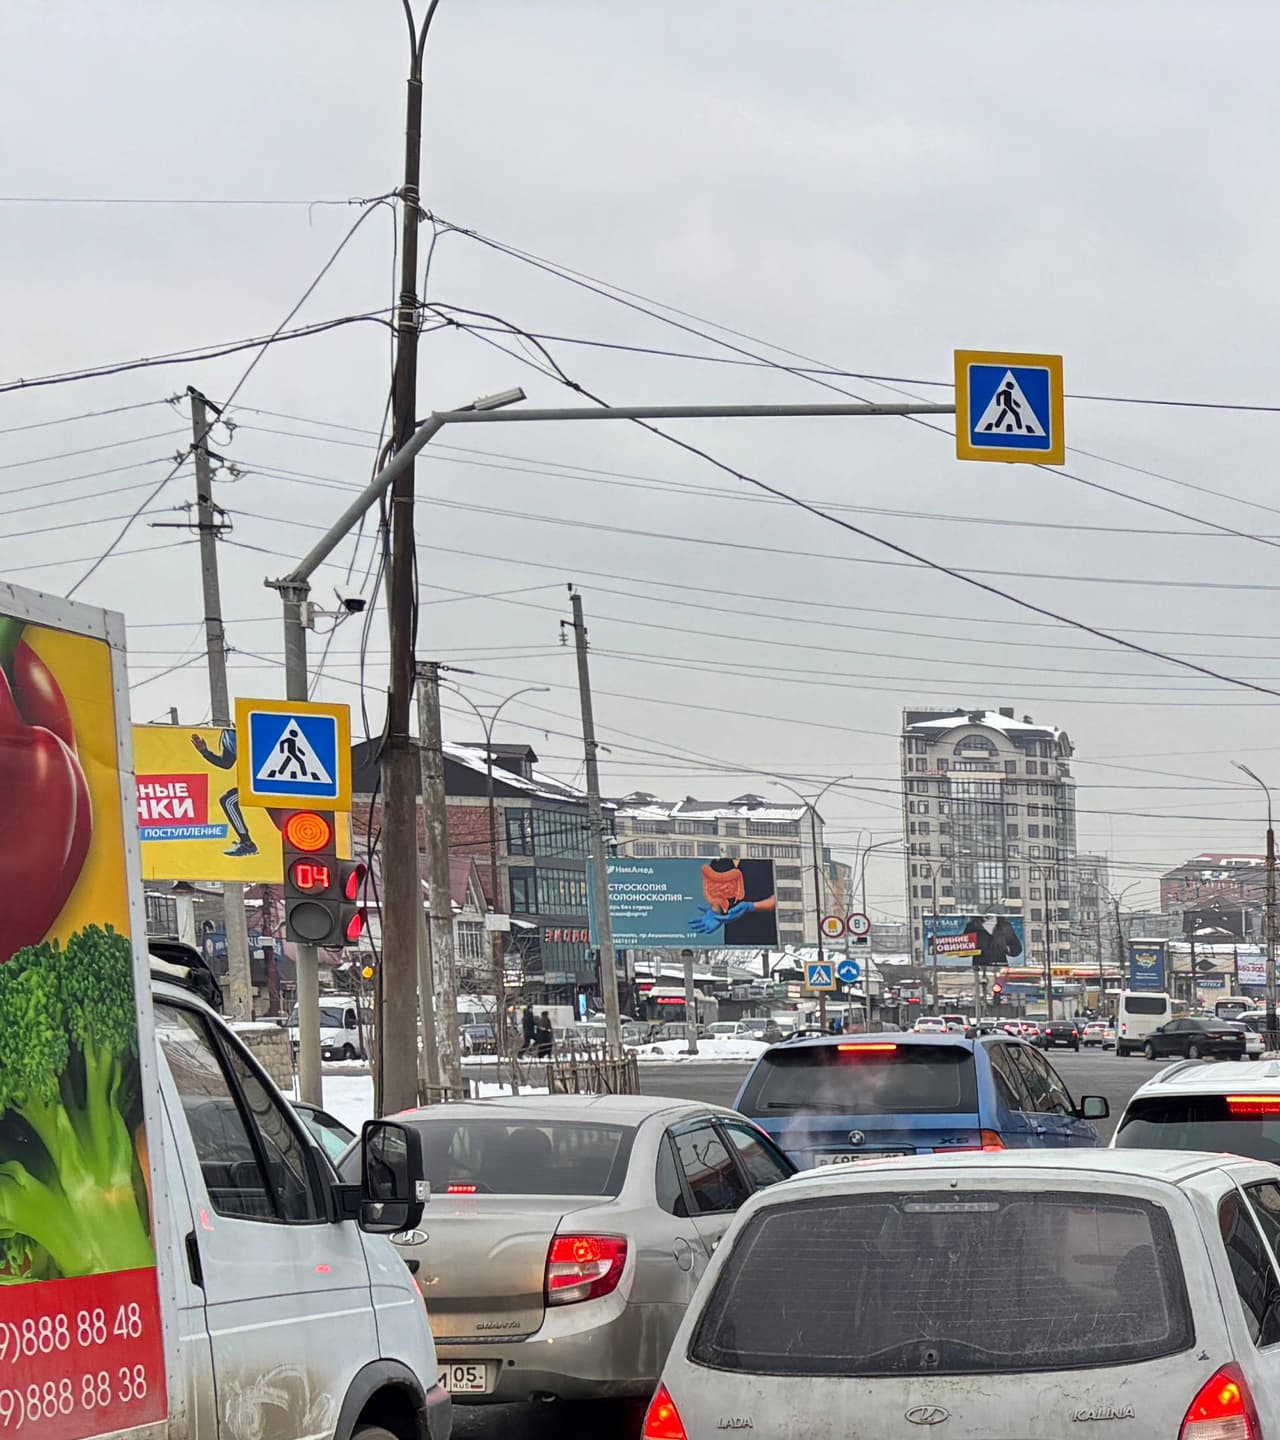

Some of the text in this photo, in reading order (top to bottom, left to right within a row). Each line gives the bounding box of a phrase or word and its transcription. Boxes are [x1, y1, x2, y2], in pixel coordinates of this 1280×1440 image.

[144, 827, 224, 837] ПОСТУПЛЕНИЕ
[297, 866, 328, 888] 04
[608, 883, 667, 891] СТРОСКОПИЯ
[77, 1308, 107, 1346] 88
[113, 1302, 142, 1340] 48
[454, 1367, 477, 1382] 05
[81, 1371, 112, 1410] 88
[118, 1365, 147, 1402] 38
[1072, 1406, 1135, 1422] KALINA
